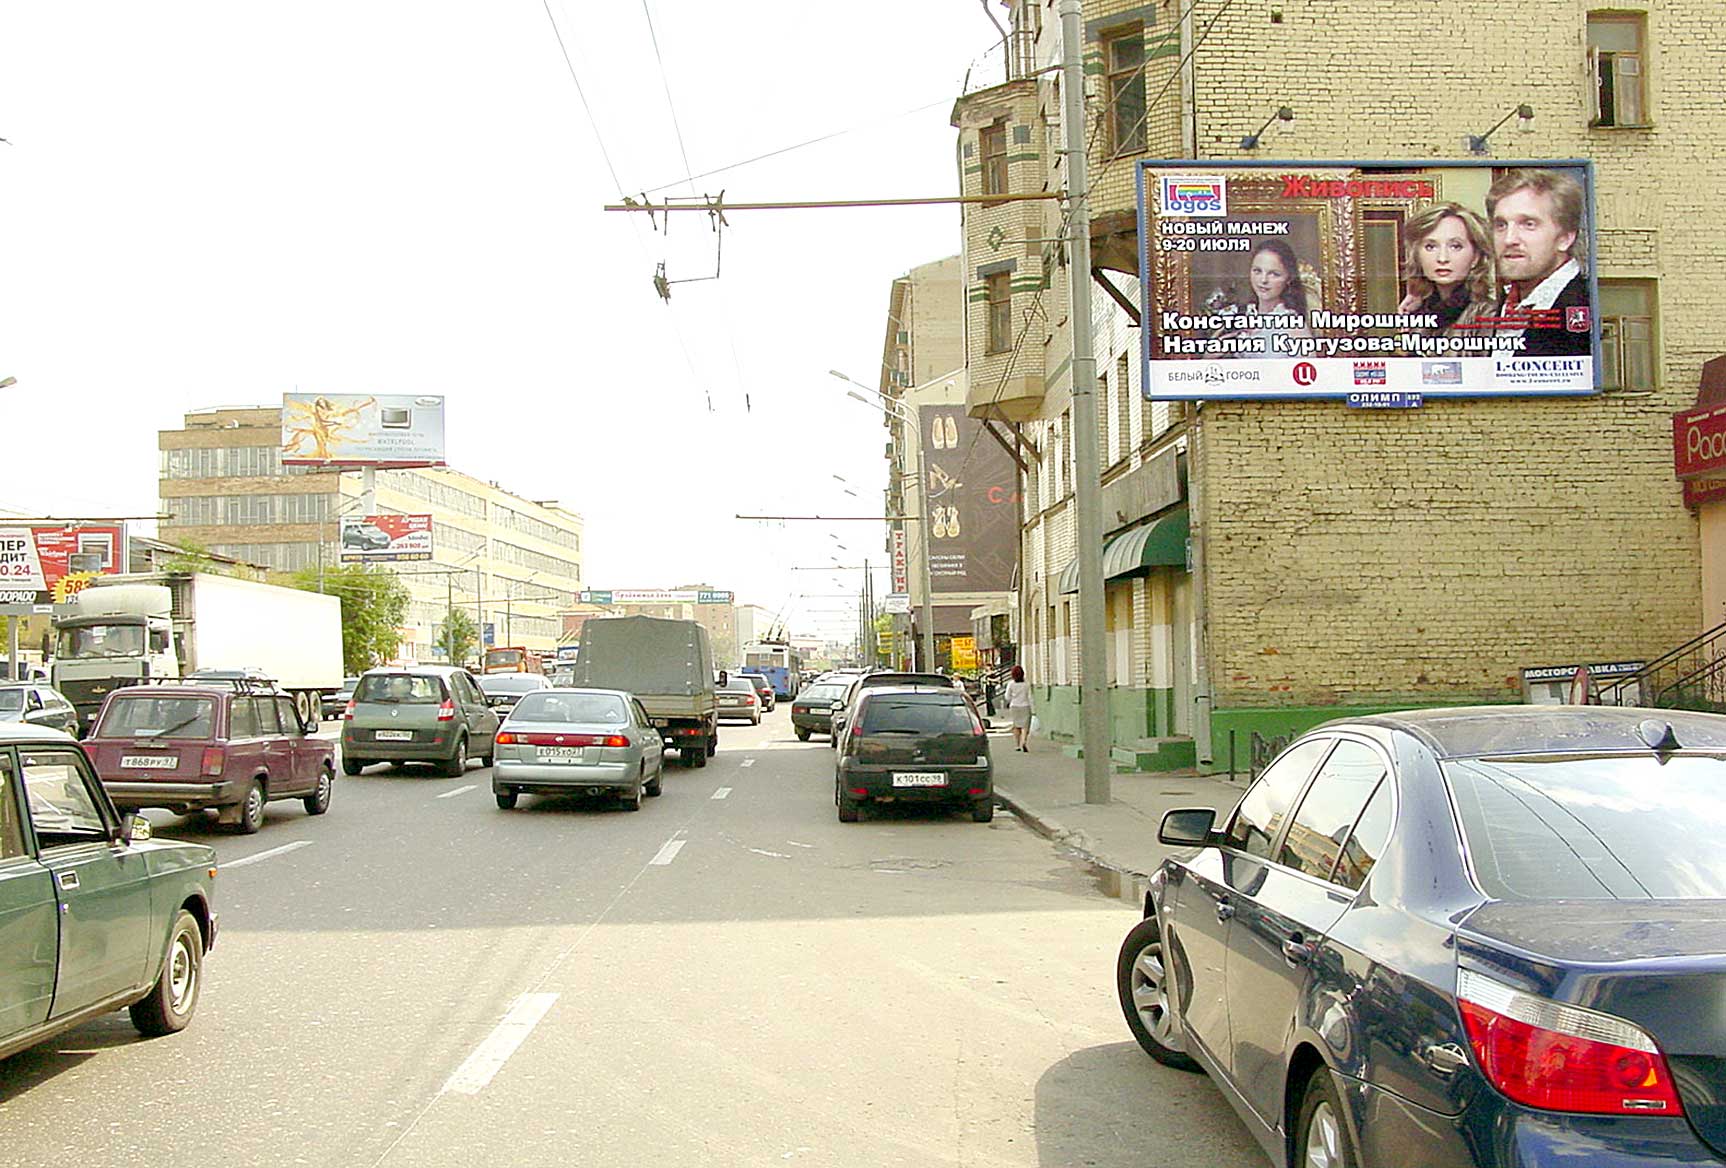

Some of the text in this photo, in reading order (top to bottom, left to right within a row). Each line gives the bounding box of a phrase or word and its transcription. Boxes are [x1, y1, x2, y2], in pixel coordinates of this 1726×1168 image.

[1281, 175, 1434, 198] Живопись
[1164, 178, 1221, 213] logos
[1162, 221, 1288, 234] НОВЫЙ МАНЕЖ
[1162, 239, 1250, 251] 9-20 ИЮЛЯ
[1163, 312, 1304, 330] Константин
[1312, 311, 1438, 332] Мирошник
[1163, 333, 1527, 356] Наталия Кургузова-Мирошник
[1496, 360, 1585, 372] L-CONCERT
[1168, 370, 1261, 382] БЕЛЫЙ ГОРОД
[1350, 393, 1400, 402] ОЛИМП
